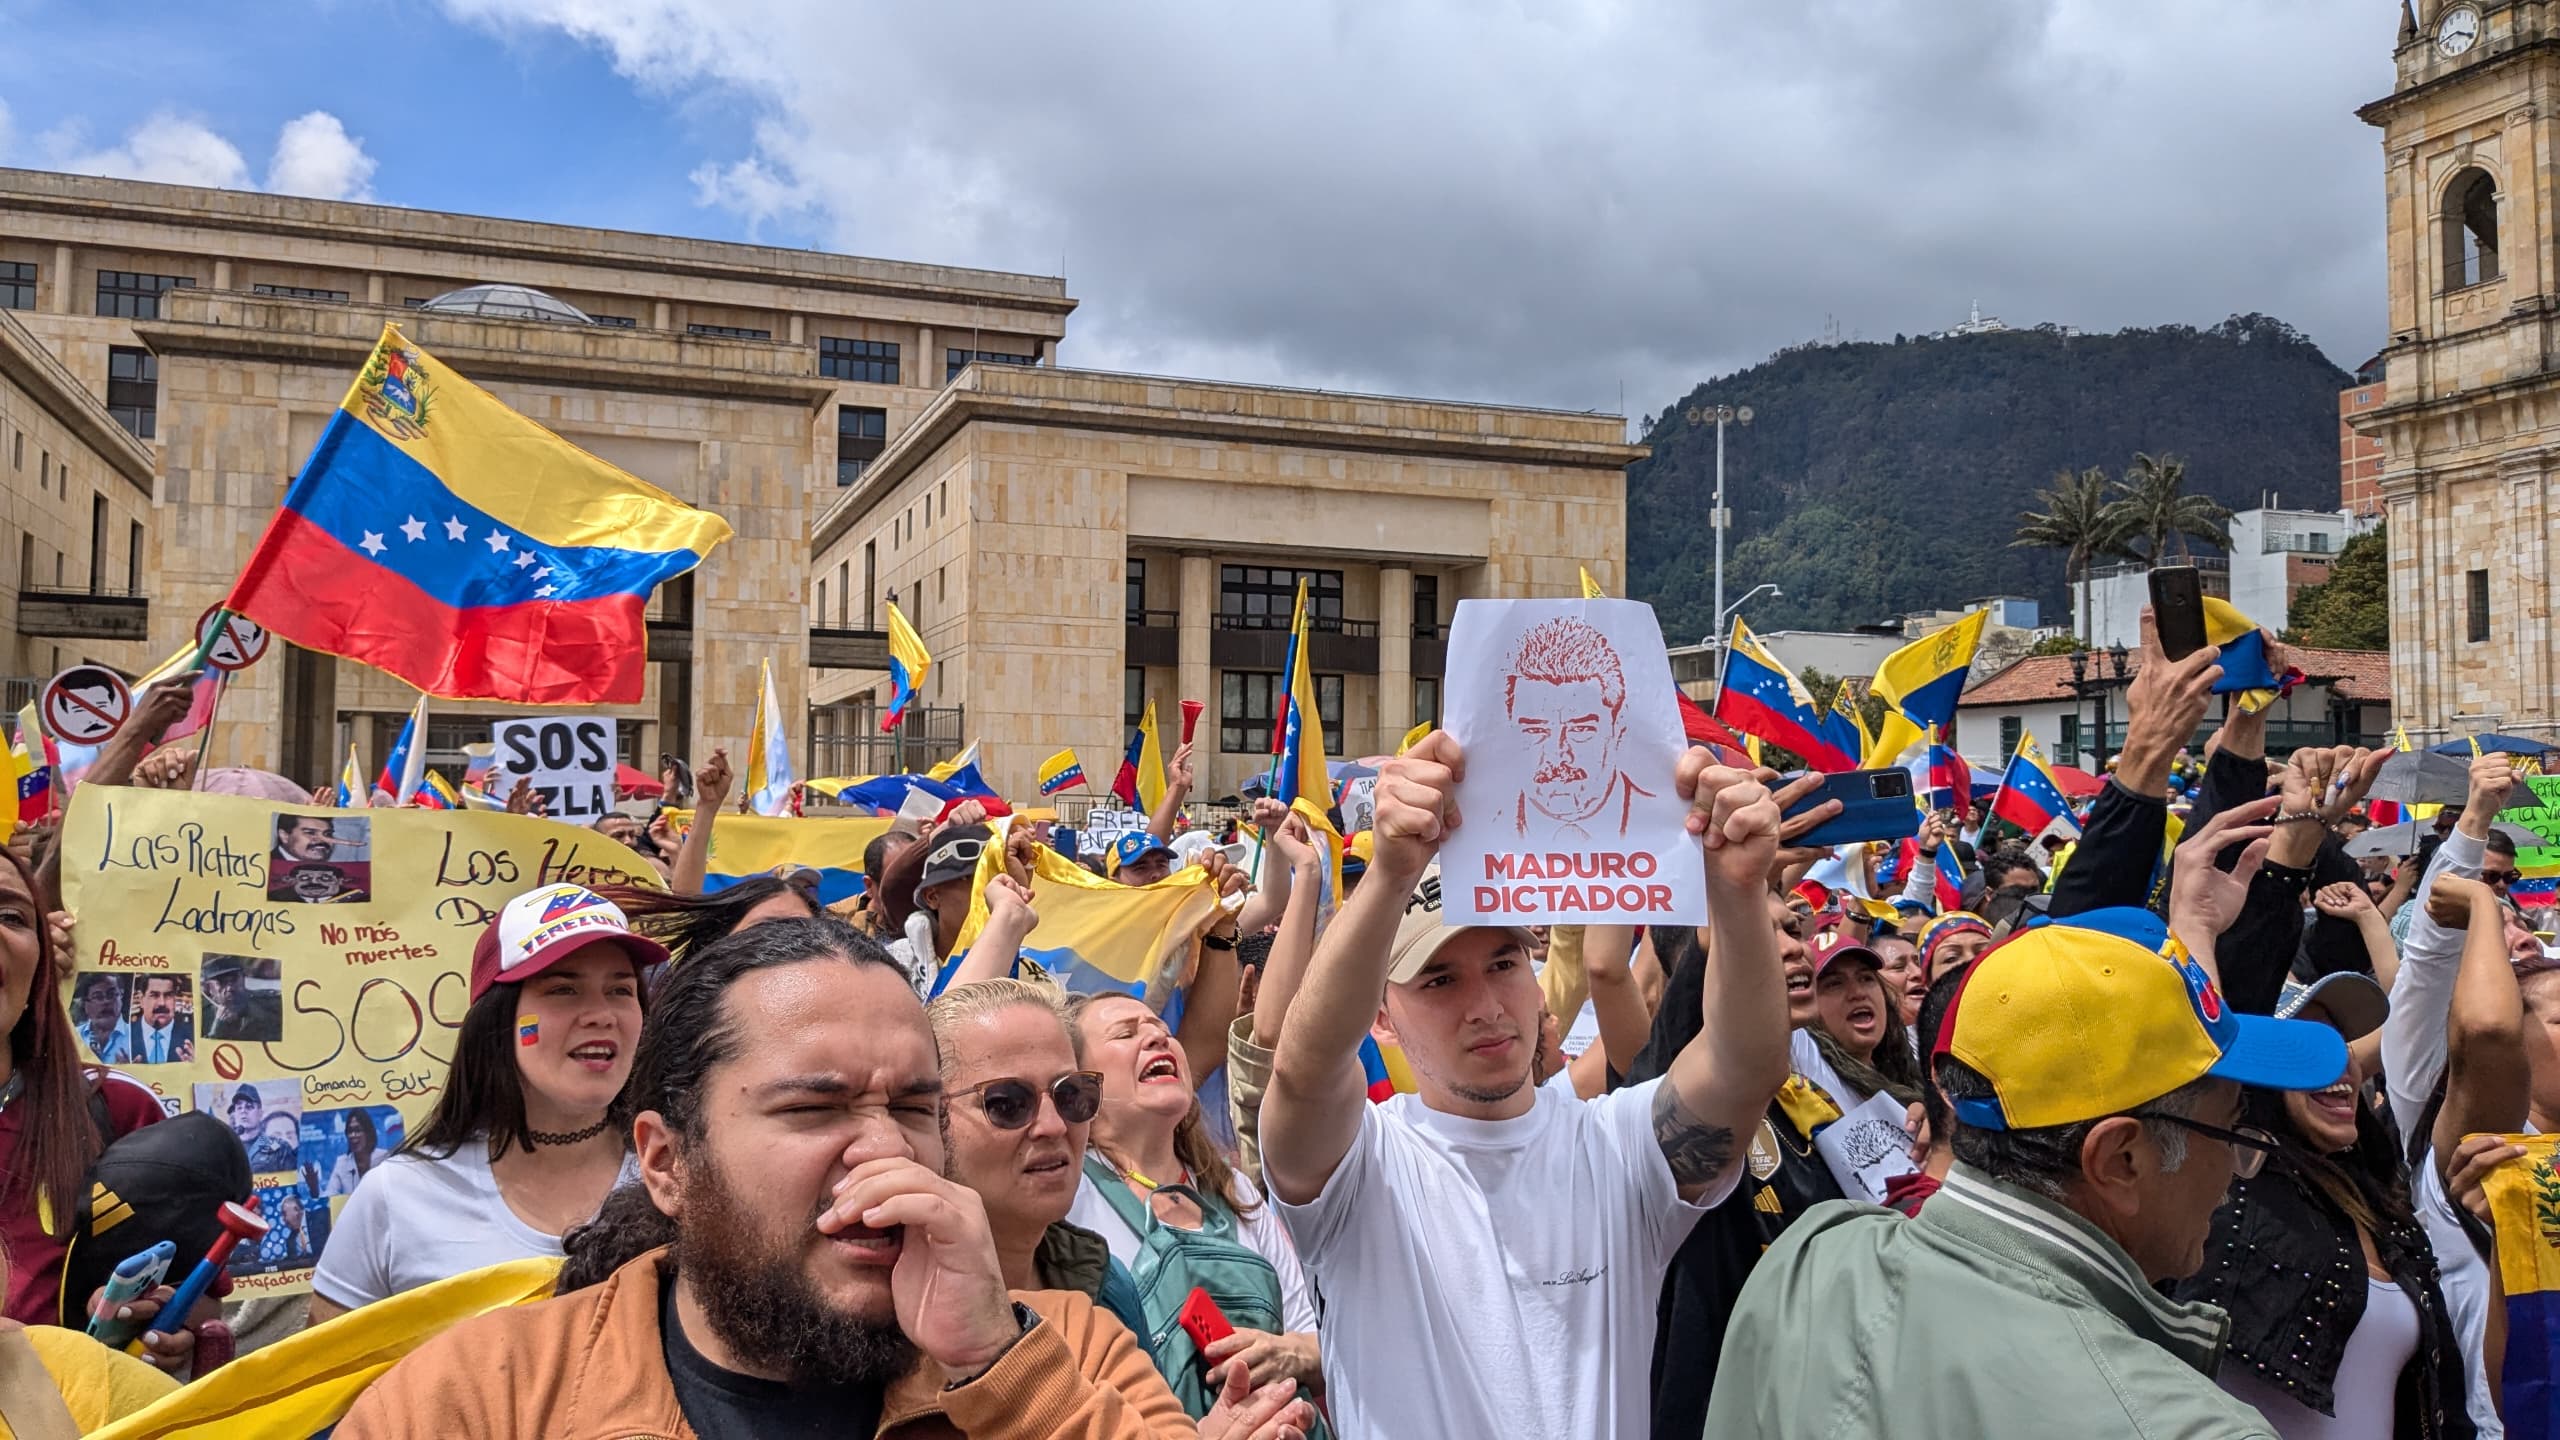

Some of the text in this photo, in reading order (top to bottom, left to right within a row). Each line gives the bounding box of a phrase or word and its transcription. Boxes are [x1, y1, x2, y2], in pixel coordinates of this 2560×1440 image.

[510, 785, 607, 816] ZLA
[98, 803, 266, 888] Las Ratas
[436, 831, 520, 887] Los
[1484, 852, 1657, 880] MADURO
[1474, 885, 1674, 913] DICTADOR
[154, 877, 296, 951] Ladronas
[320, 921, 400, 946] No más
[345, 943, 438, 965] muertes
[304, 1074, 366, 1094] Comando
[232, 1271, 316, 1292] stafadore
